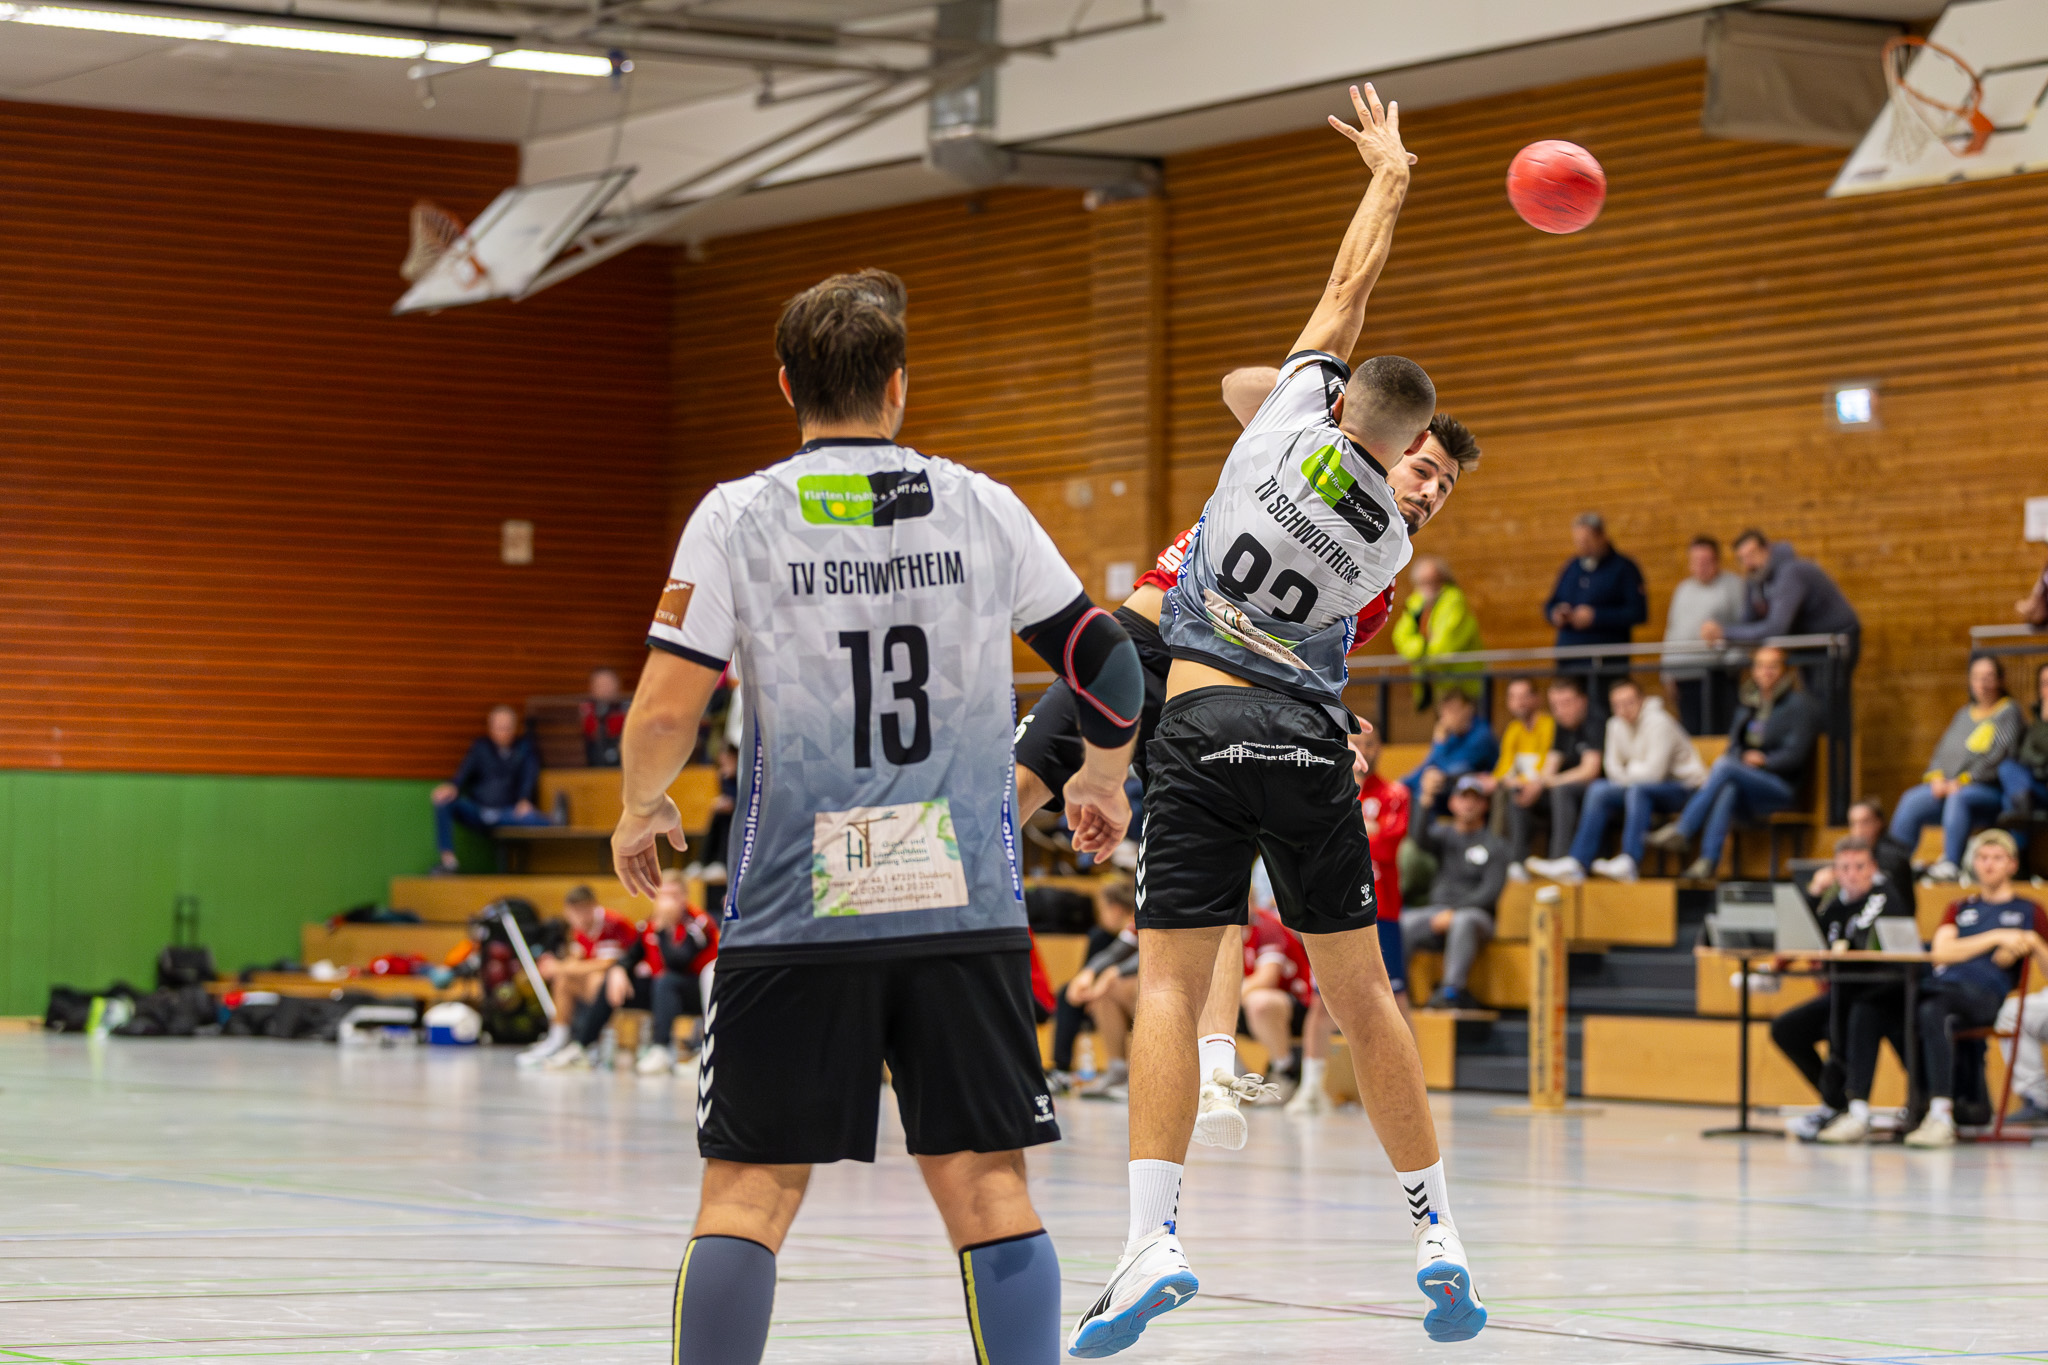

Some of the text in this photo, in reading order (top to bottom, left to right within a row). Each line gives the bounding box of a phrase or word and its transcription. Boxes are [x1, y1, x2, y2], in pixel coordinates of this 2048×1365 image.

[911, 482, 929, 494] AG
[1255, 474, 1280, 502] TV
[1316, 454, 1335, 478] Flatten
[1332, 477, 1352, 500] Finanz
[1354, 503, 1374, 522] Sport
[1372, 520, 1385, 532] AG
[788, 562, 815, 596] TV
[838, 625, 932, 769] 13
